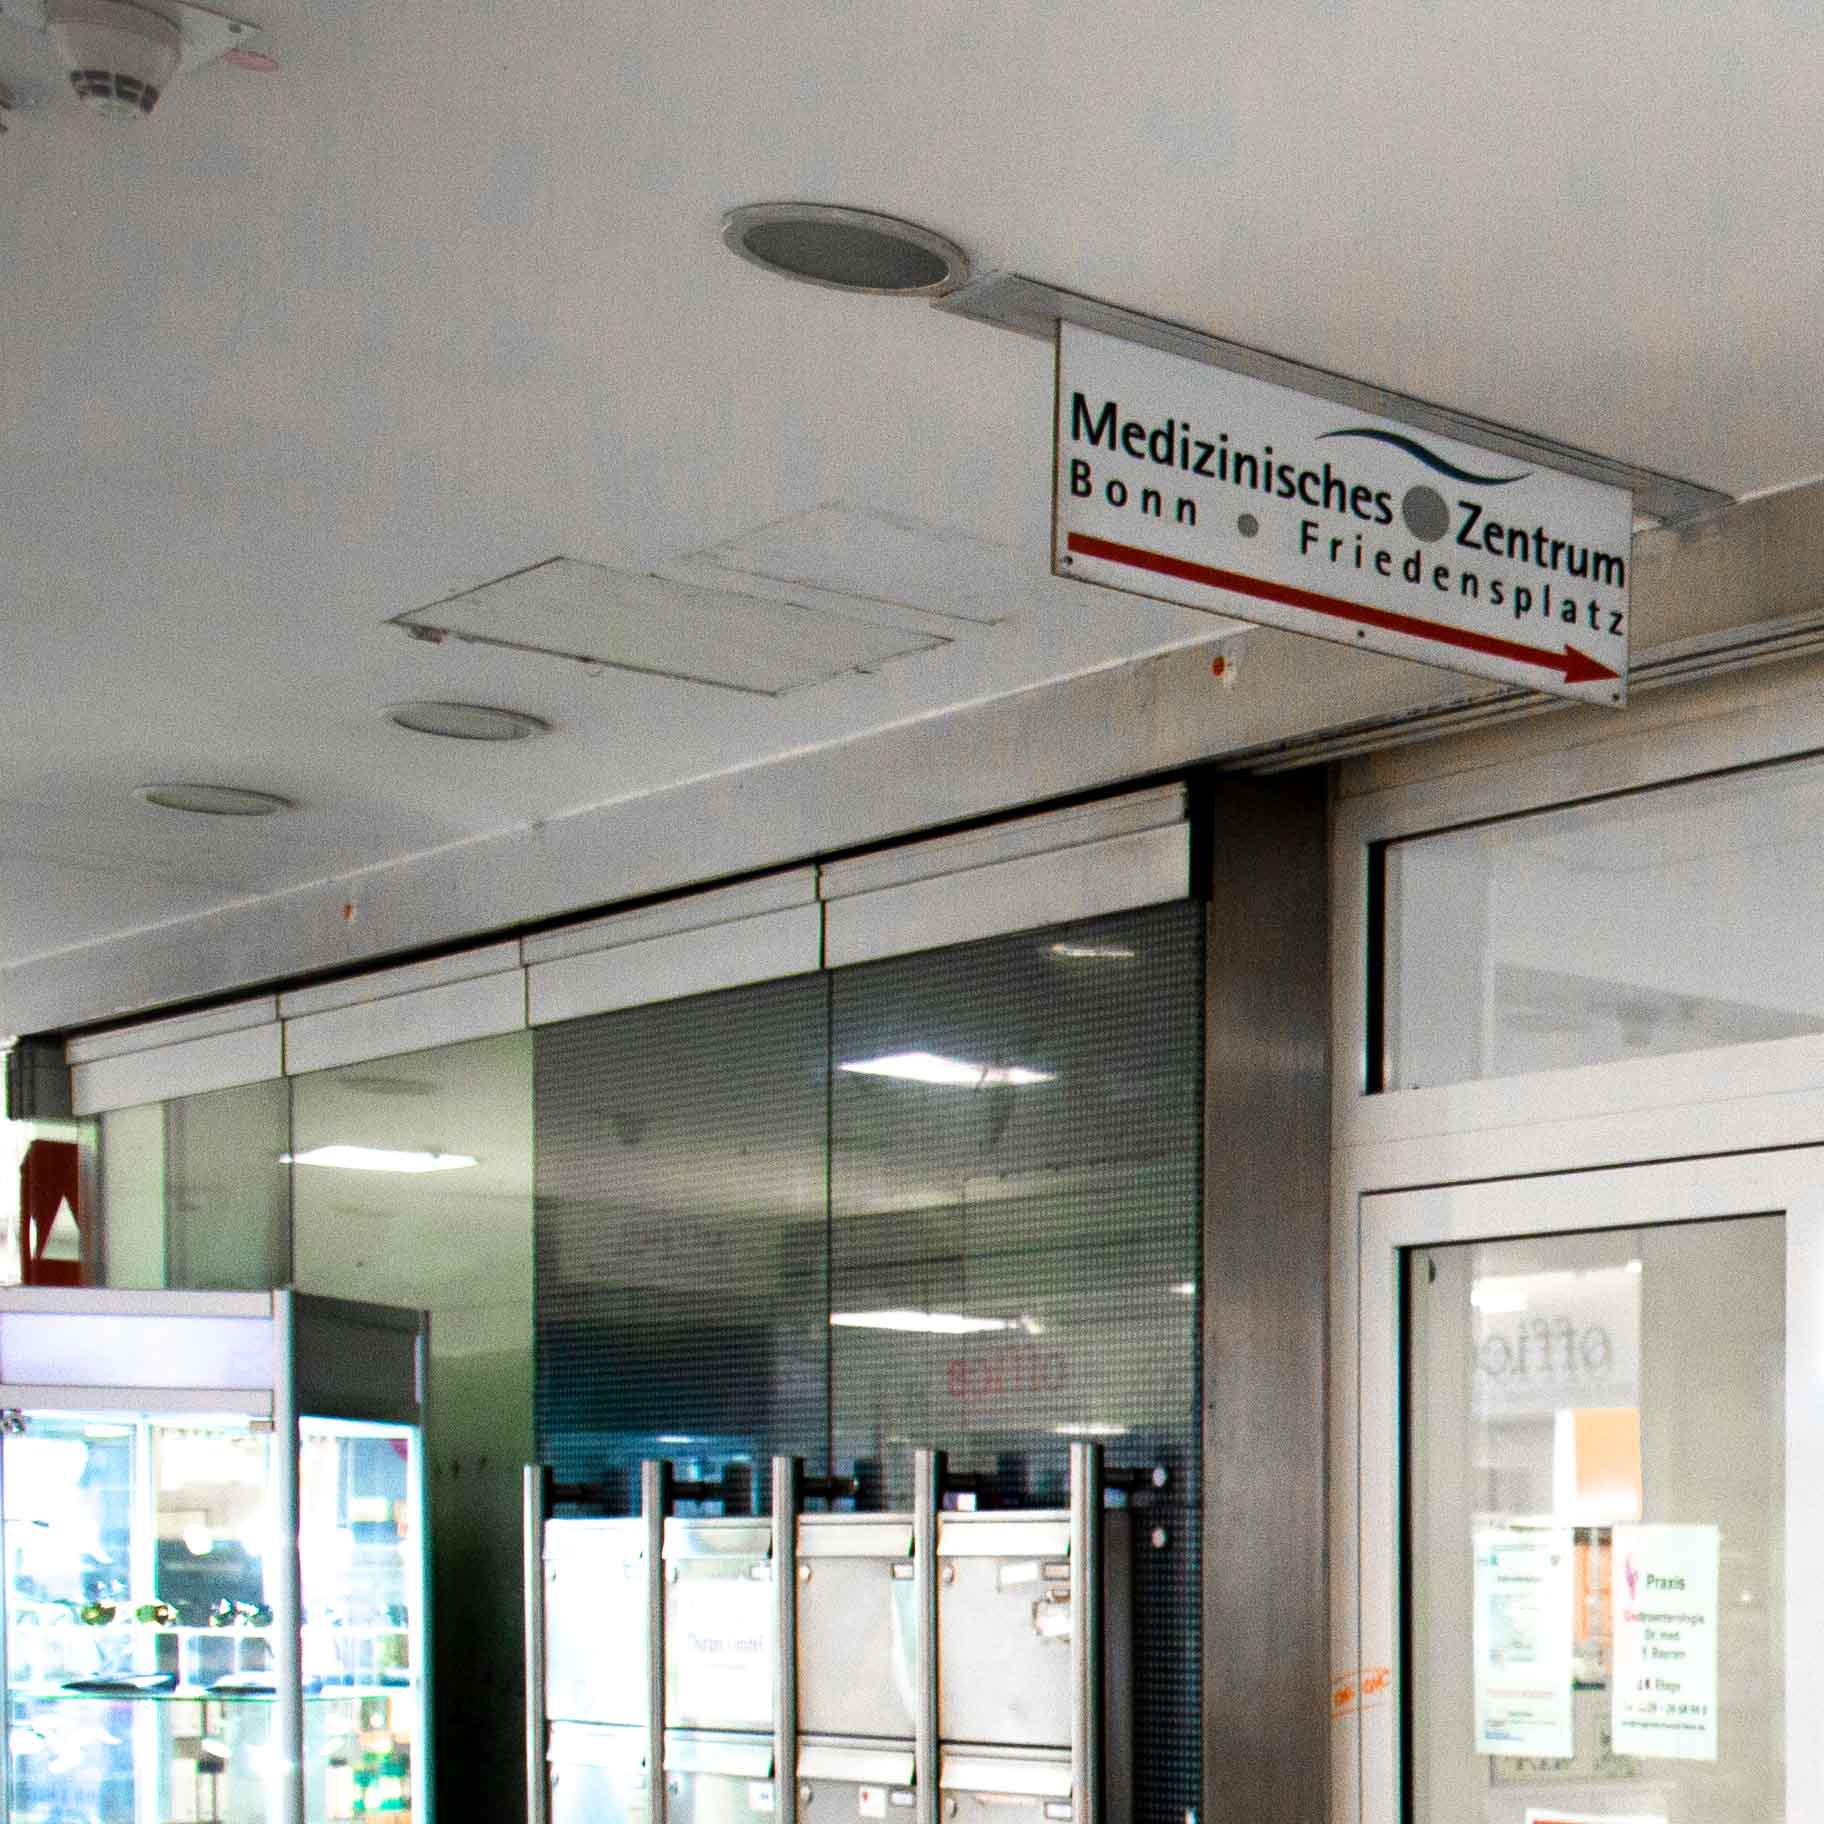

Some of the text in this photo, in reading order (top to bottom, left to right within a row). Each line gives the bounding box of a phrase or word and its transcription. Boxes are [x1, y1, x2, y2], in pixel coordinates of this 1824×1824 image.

[1070, 458, 1624, 637] Bonn Friedensplatz
[1071, 391, 1626, 589] Medizinisches Zentrum
